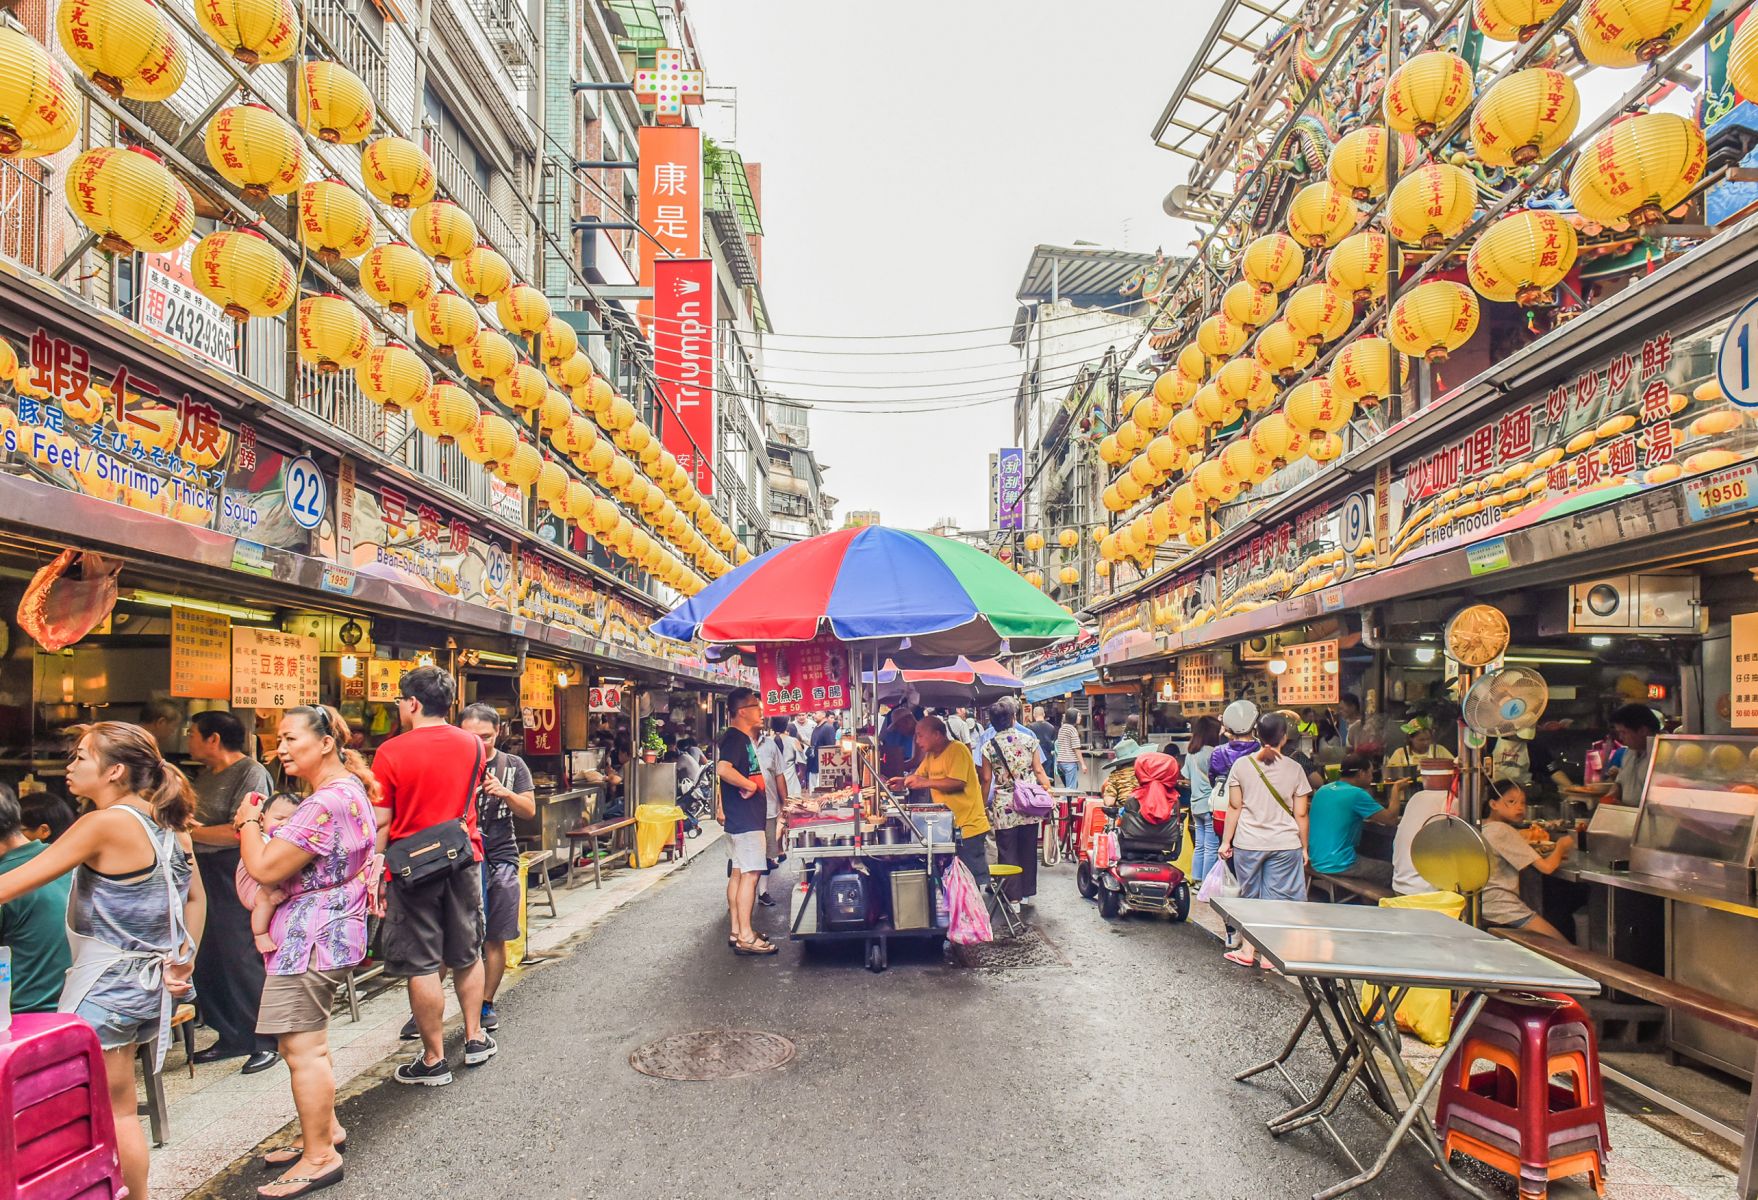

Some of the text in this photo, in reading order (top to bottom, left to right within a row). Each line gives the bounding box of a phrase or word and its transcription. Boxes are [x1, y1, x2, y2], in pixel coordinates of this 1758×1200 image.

[652, 161, 688, 258] 康是
[147, 288, 166, 321] 租
[676, 301, 700, 414] Triumph
[1641, 330, 1674, 467] 鮮魚湯
[1404, 404, 1533, 508] 炒咖哩麵
[171, 478, 214, 512] Thick
[223, 496, 258, 528] Soup
[292, 467, 320, 517] 22
[1702, 481, 1743, 507] 1950
[1345, 503, 1360, 543] 19
[1424, 505, 1502, 546] Fried noodle
[330, 573, 348, 587] 1950
[489, 550, 503, 583] 26
[250, 697, 258, 705] 60
[274, 694, 285, 706] 65
